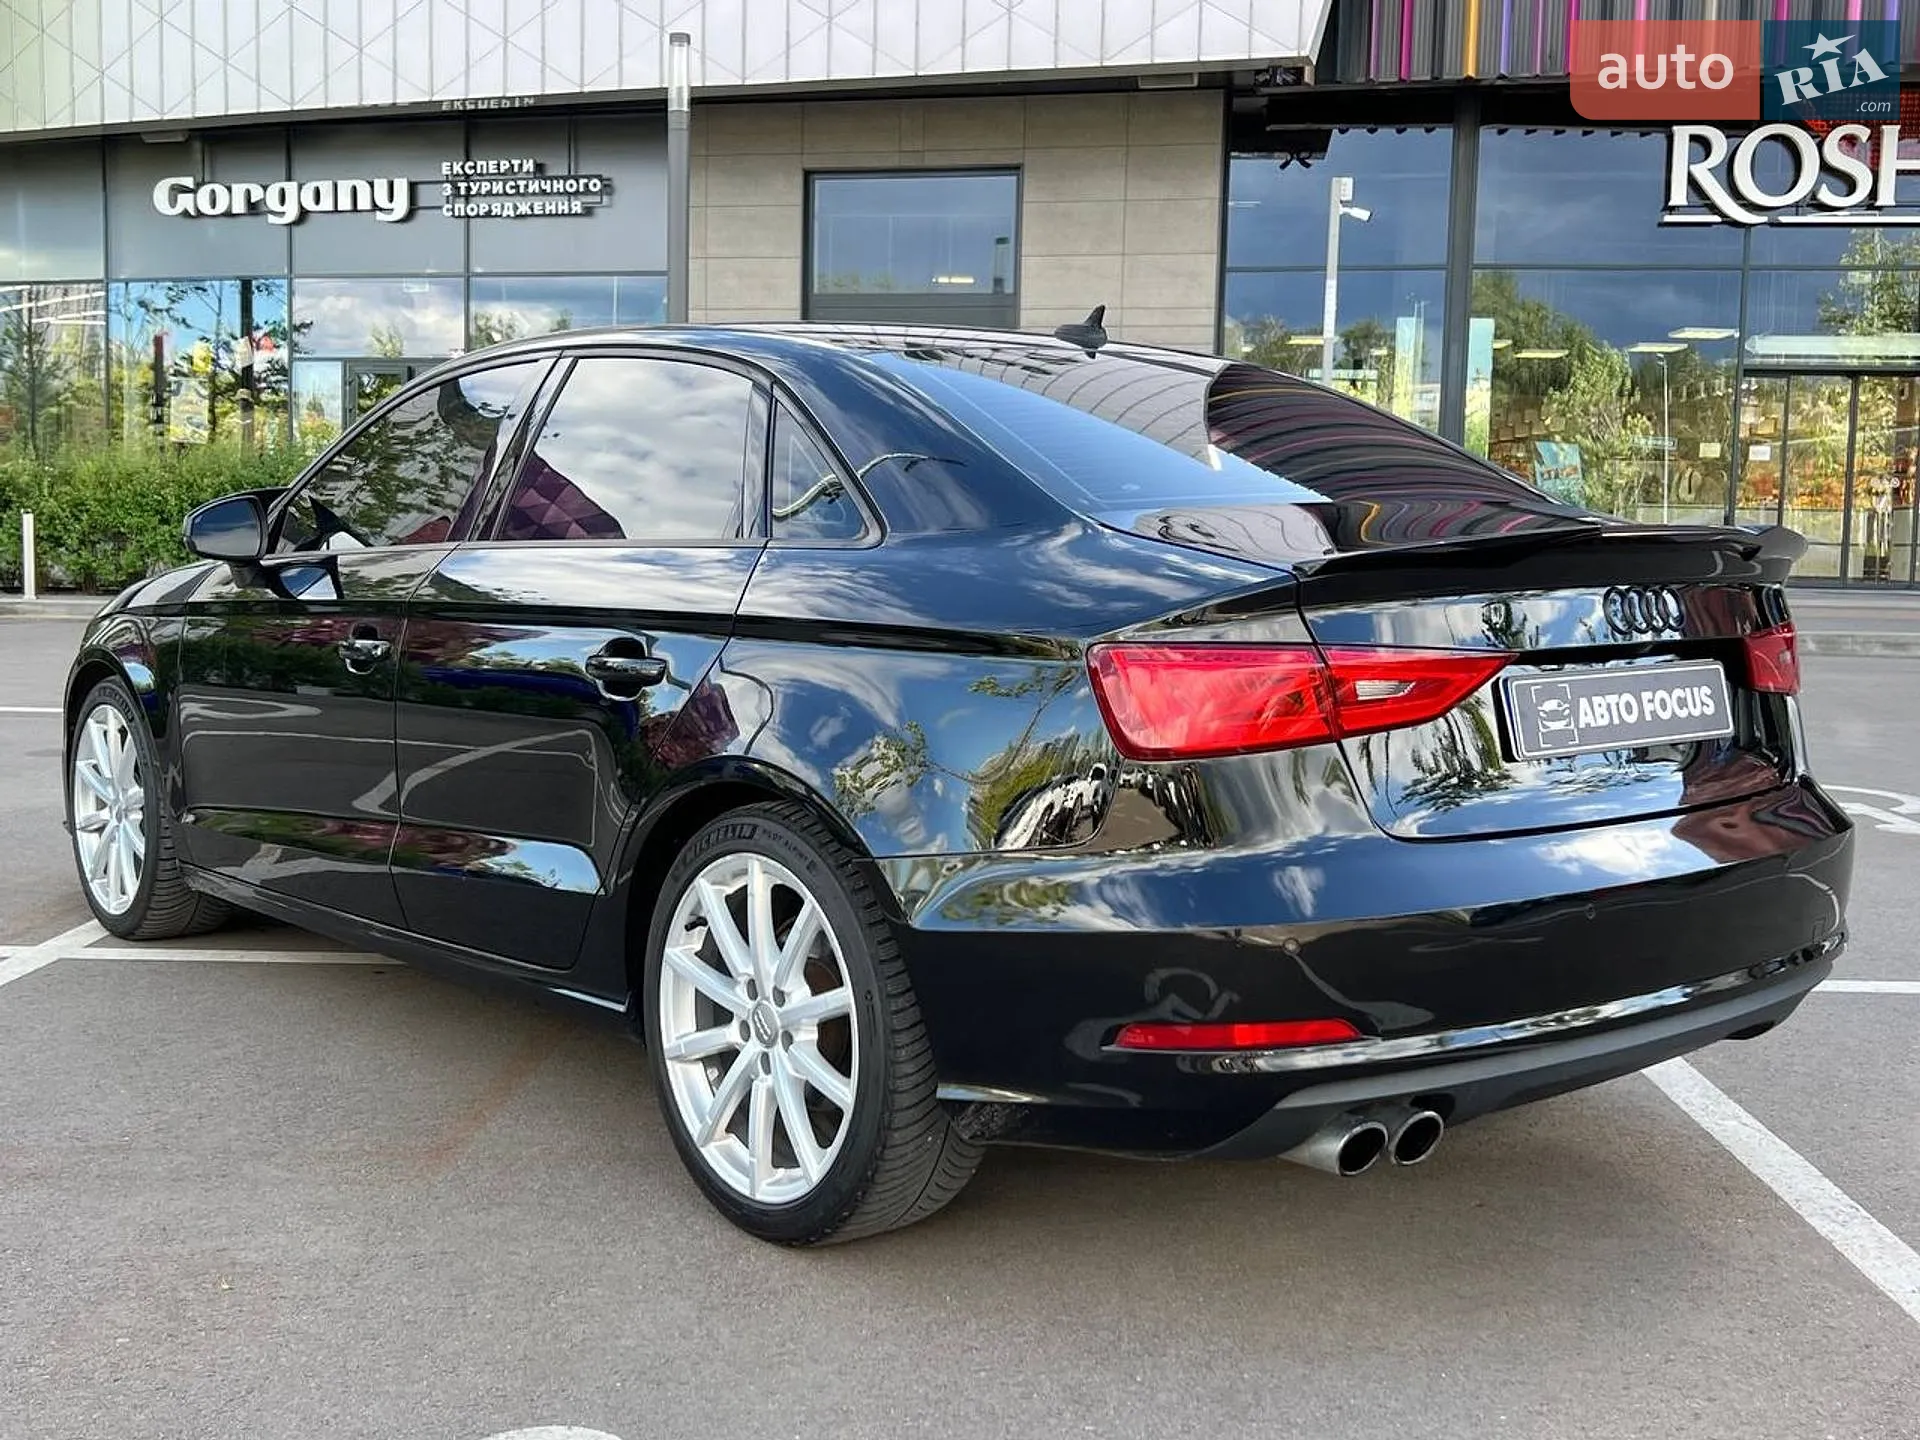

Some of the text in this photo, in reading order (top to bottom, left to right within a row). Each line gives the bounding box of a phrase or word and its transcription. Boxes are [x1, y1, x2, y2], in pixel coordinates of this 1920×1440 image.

[441, 159, 536, 175] ЕКСПЕРТИ
[458, 178, 602, 196] ТУРИСТИЧНОГО
[152, 176, 411, 226] Gorgany
[442, 201, 584, 218] СПОРЯДЖЕННЯ
[1579, 685, 1716, 729] АВТО FOCUS
